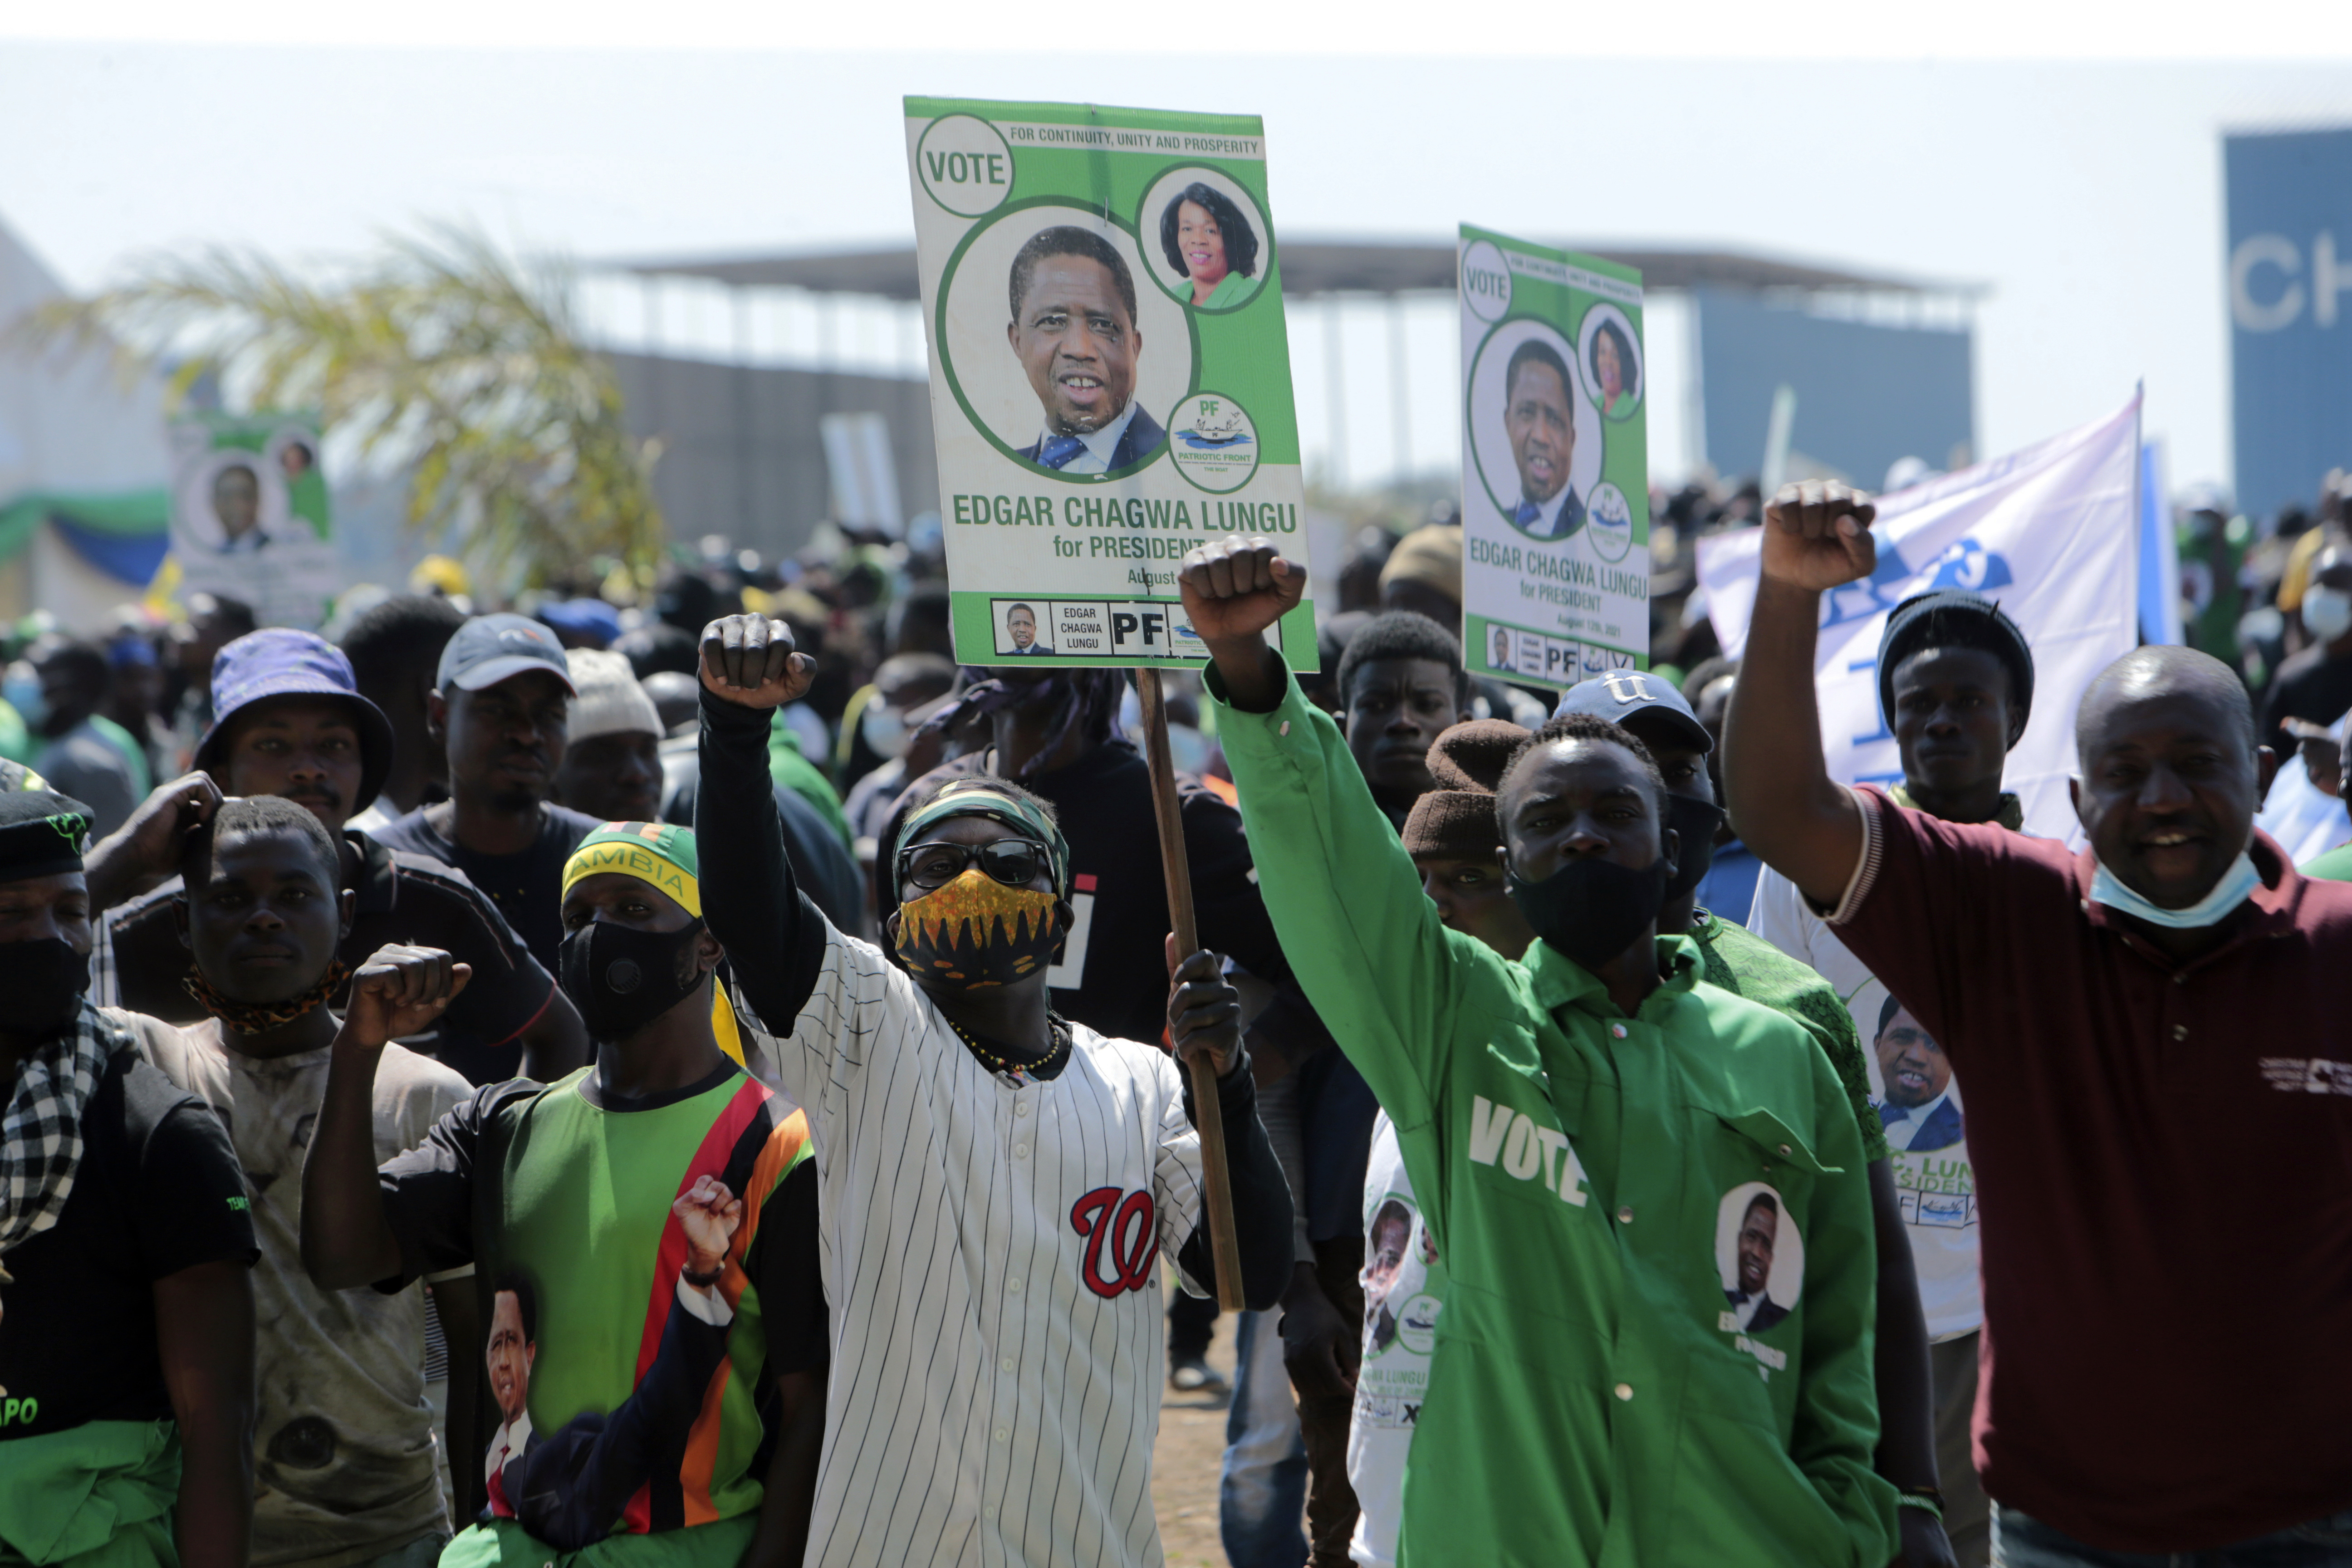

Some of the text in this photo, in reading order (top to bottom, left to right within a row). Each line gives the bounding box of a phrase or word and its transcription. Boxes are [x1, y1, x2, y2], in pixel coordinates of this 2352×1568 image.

[1011, 127, 1258, 154] FOR CONTINUITY, UNITY AND PROSPERITY
[926, 151, 1006, 185] VOTE
[1466, 267, 1507, 300] VOTE
[1200, 400, 1219, 416] PF
[1178, 452, 1251, 462] PATRIOTIC FRONT
[953, 494, 1296, 534] EDGAR CHAGWA LUNGU
[1053, 535, 1082, 557] for
[1128, 569, 1176, 588] August
[1470, 537, 1647, 600] EDGAR CHAGWA LUNGU
[1520, 578, 1602, 612] for PRESIDENT
[1064, 608, 1096, 618] EDGAR
[1061, 623, 1102, 634] CHAGWA
[1112, 613, 1164, 646] PF
[1067, 638, 1098, 649] LUNGU
[1548, 647, 1577, 674] PF
[570, 848, 684, 899] AMBIA
[1469, 1094, 1588, 1208] VOTE
[1922, 1157, 1974, 1179] LUN
[1071, 1186, 1158, 1299] W
[1387, 1369, 1426, 1386] LUNGU
